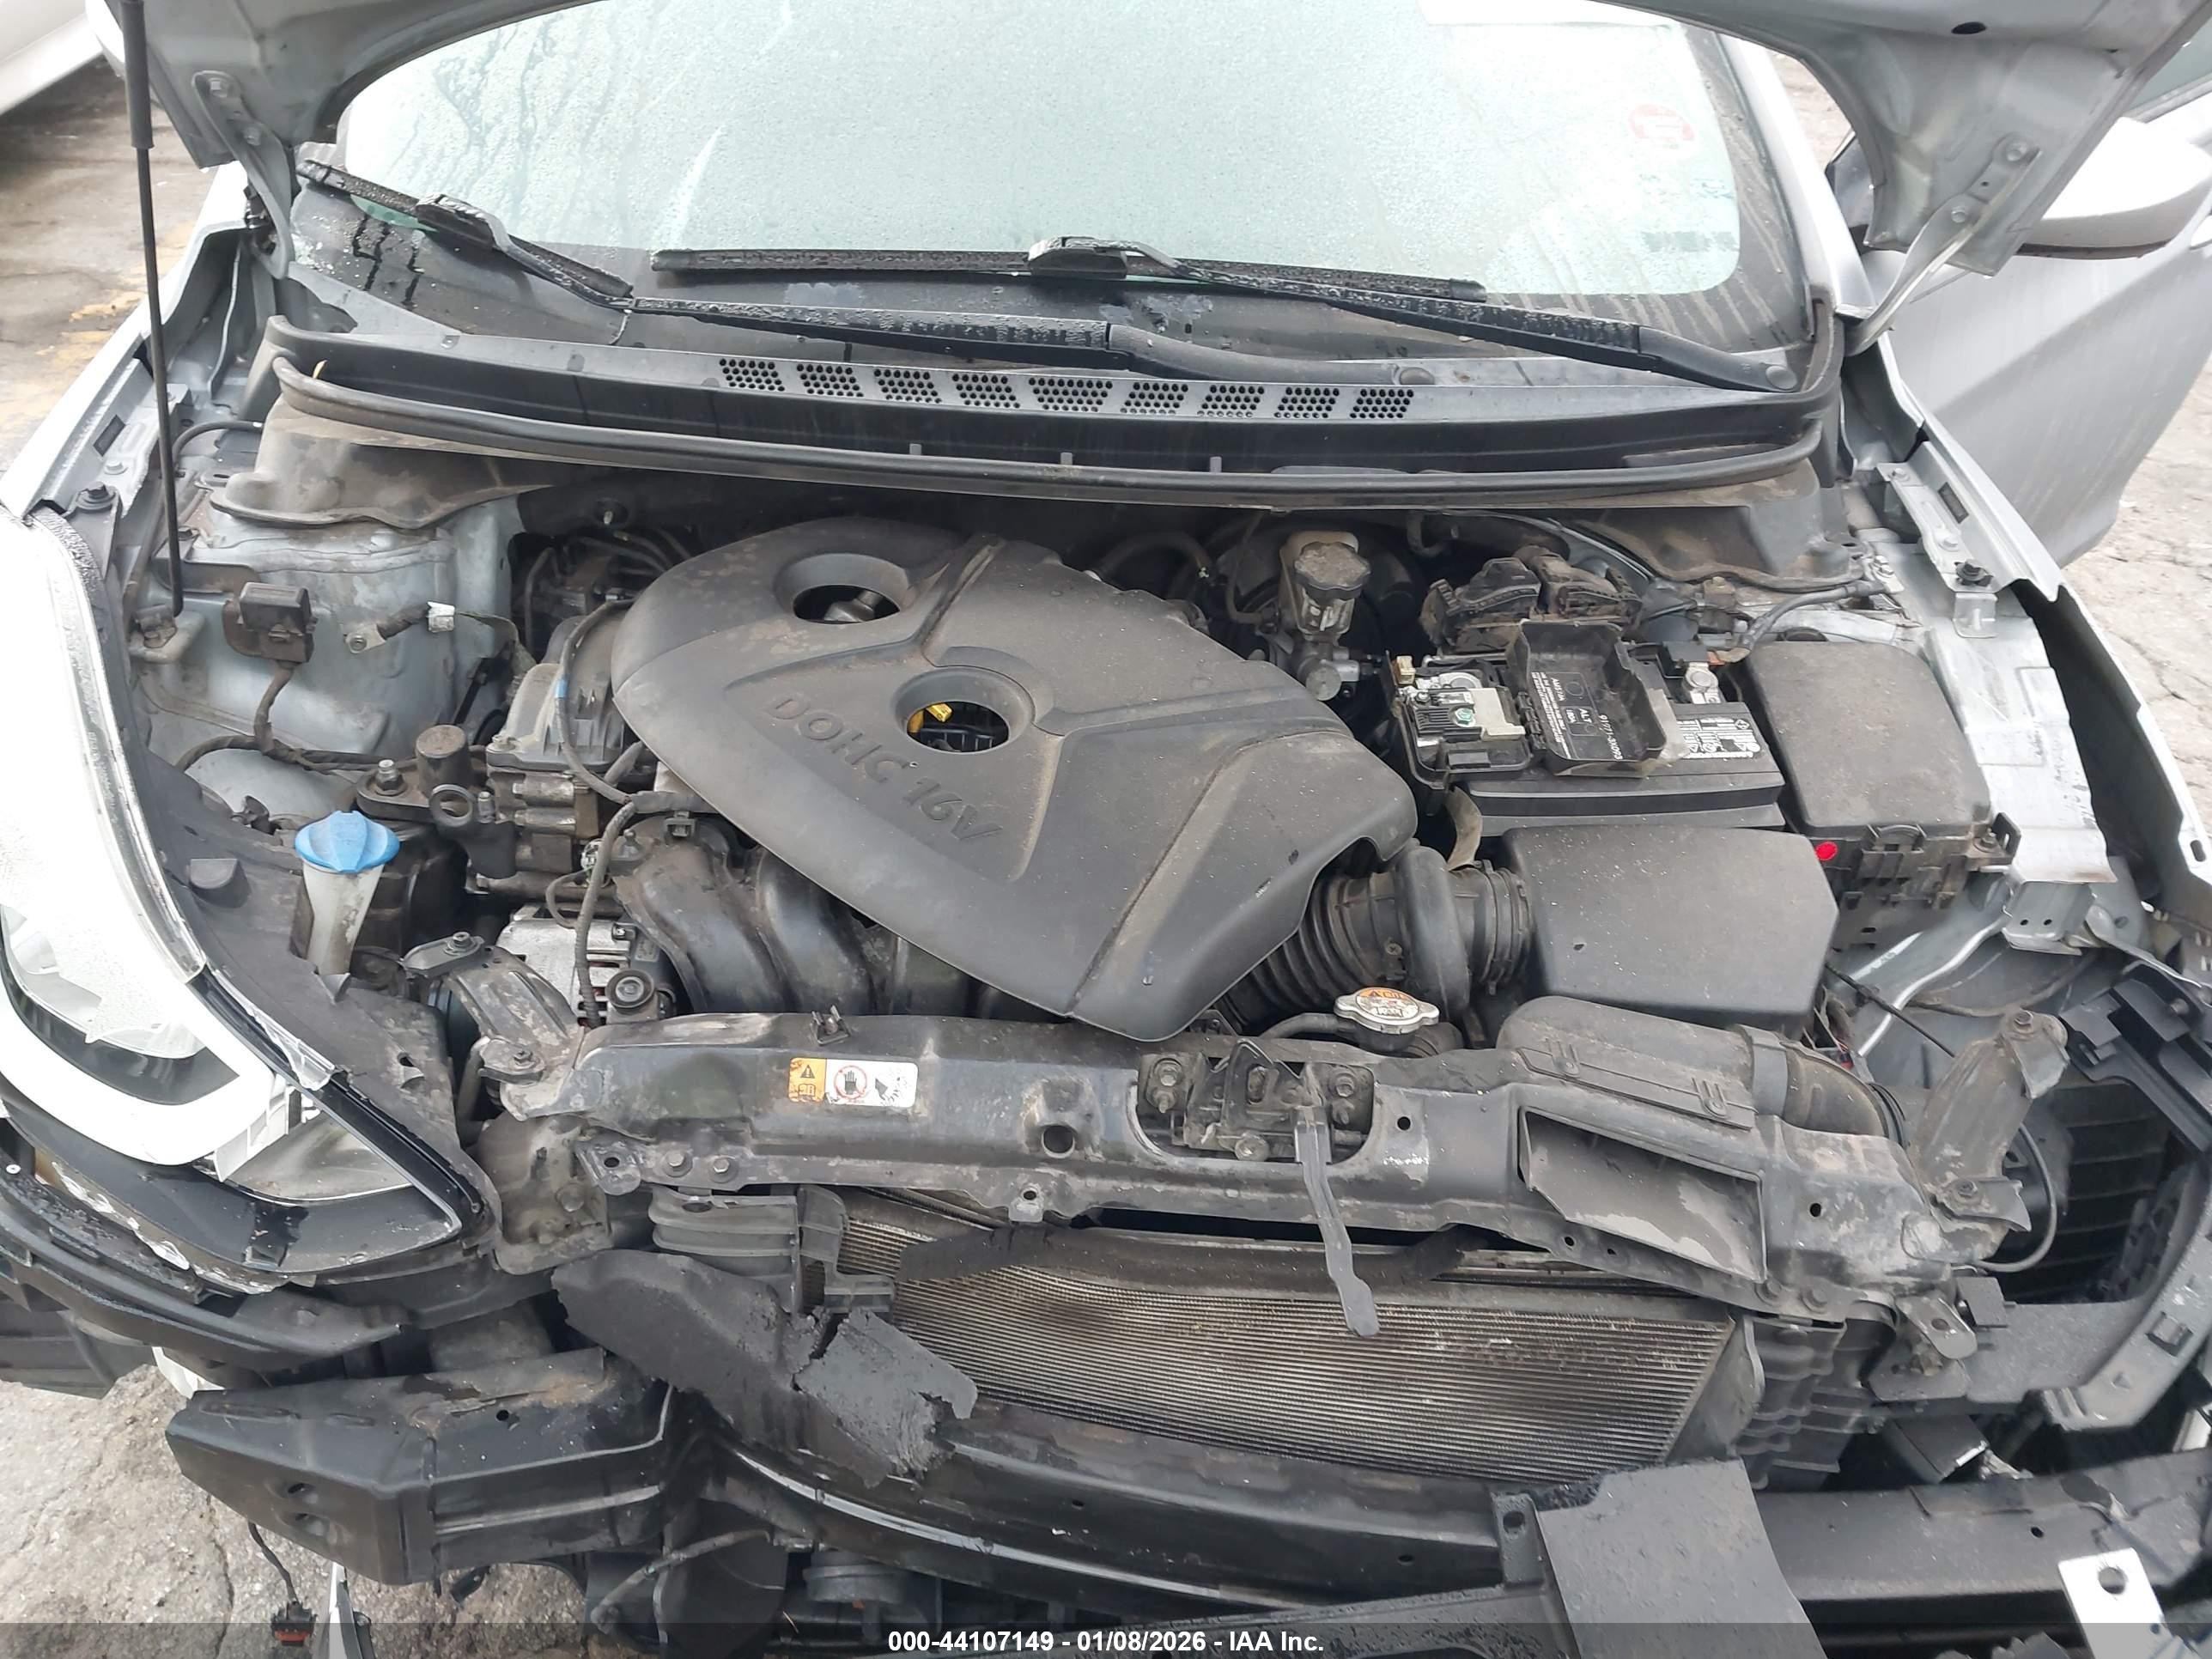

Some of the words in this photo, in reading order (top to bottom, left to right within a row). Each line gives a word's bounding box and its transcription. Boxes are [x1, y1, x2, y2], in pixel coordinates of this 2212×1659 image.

[1578, 708, 1594, 724] ALT
[766, 691, 910, 783] DOHC
[903, 776, 1003, 841] 16V
